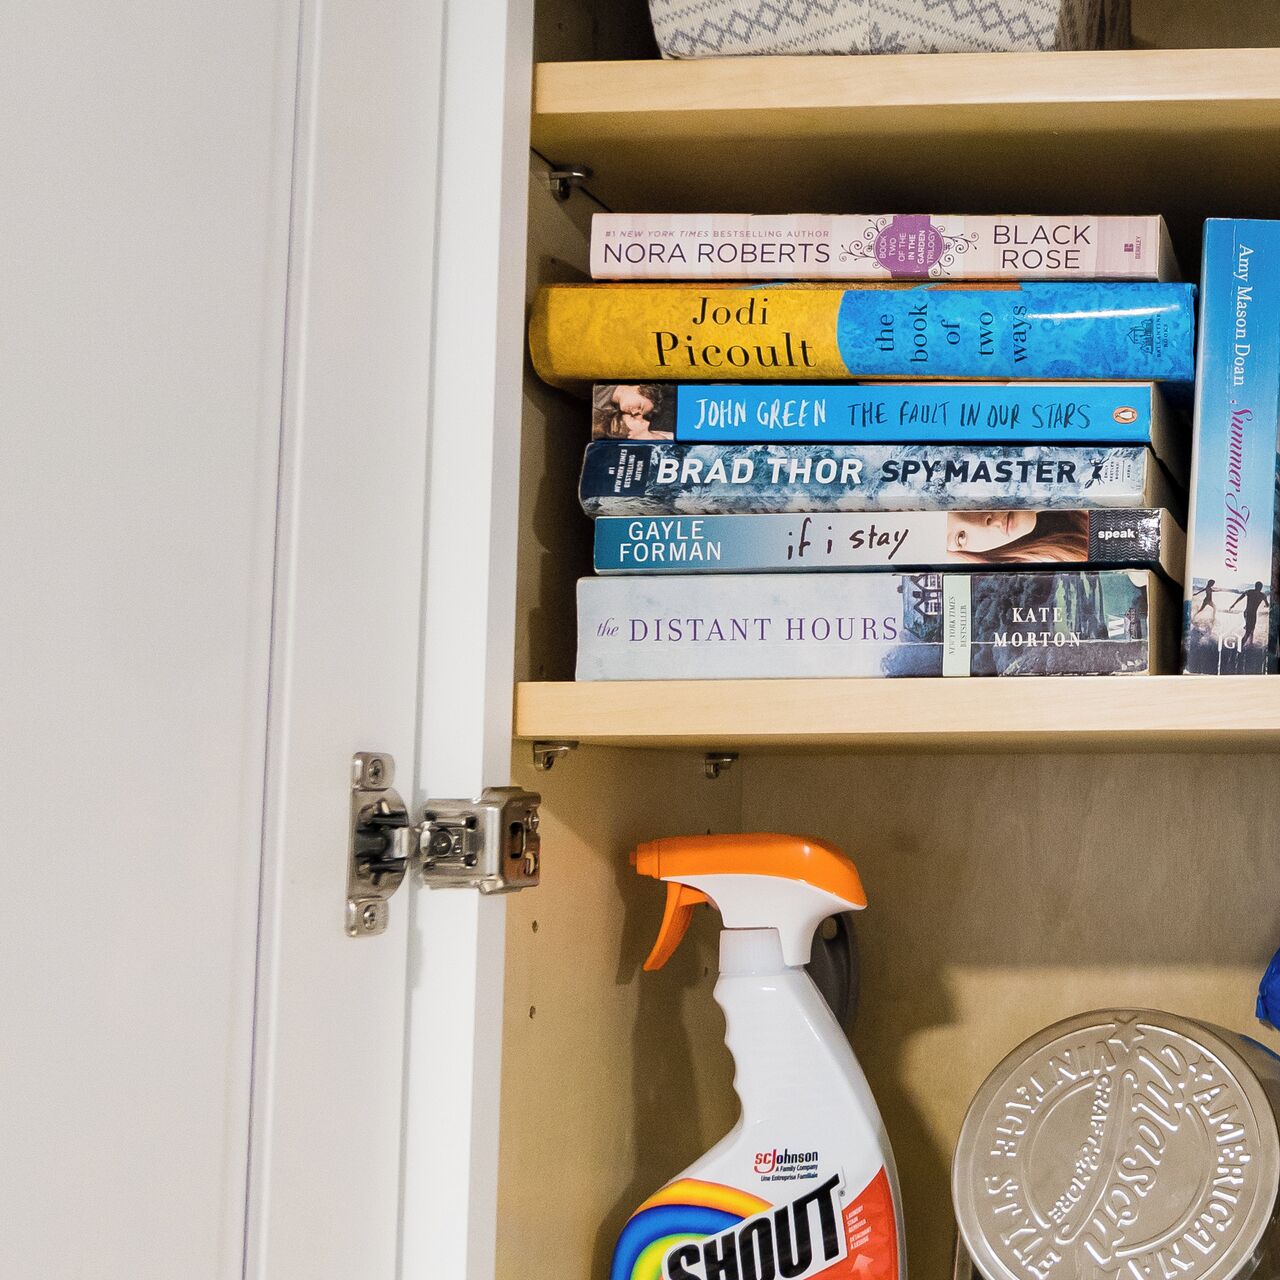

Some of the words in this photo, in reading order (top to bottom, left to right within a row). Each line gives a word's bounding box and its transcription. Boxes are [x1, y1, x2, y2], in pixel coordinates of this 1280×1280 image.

[606, 230, 618, 239] #1
[620, 230, 641, 238] NEW
[644, 230, 671, 238] YORK
[675, 230, 709, 238] TIMES
[714, 230, 781, 238] BESTSELLING
[786, 230, 829, 238] AUTHOR
[993, 225, 1091, 245] BLACK
[604, 243, 689, 264] NORA
[697, 242, 830, 264] ROBERTS
[1001, 249, 1080, 269] ROSE
[1232, 243, 1254, 281] Amy
[692, 296, 769, 327] Jodi
[1234, 285, 1252, 340] Mason
[876, 314, 895, 352] the
[910, 303, 928, 363] book
[946, 320, 961, 346] of
[978, 310, 994, 356] two
[1012, 305, 1029, 363] ways
[653, 331, 816, 368] Picoult
[1233, 343, 1250, 385] Doan
[695, 397, 752, 430] JOHN
[757, 398, 826, 427] GREEN
[848, 403, 887, 426] THE
[899, 403, 947, 425] FAULT
[960, 404, 982, 426] IN
[987, 403, 1022, 427] OUR
[1031, 403, 1090, 428] STARS
[658, 459, 756, 484] BRAD
[767, 458, 863, 483] THOR
[881, 459, 1076, 484] SPYMASTER
[629, 521, 704, 541] GAYLE
[788, 517, 812, 560] if
[826, 527, 832, 554] i
[850, 526, 909, 559] stay
[1099, 529, 1135, 543] speak
[620, 541, 722, 561] FORMAN
[1012, 606, 1063, 623] KATE
[597, 618, 619, 637] the
[629, 617, 776, 642] DISTANT
[785, 616, 898, 642] HOURS
[994, 630, 1081, 647] MORTON
